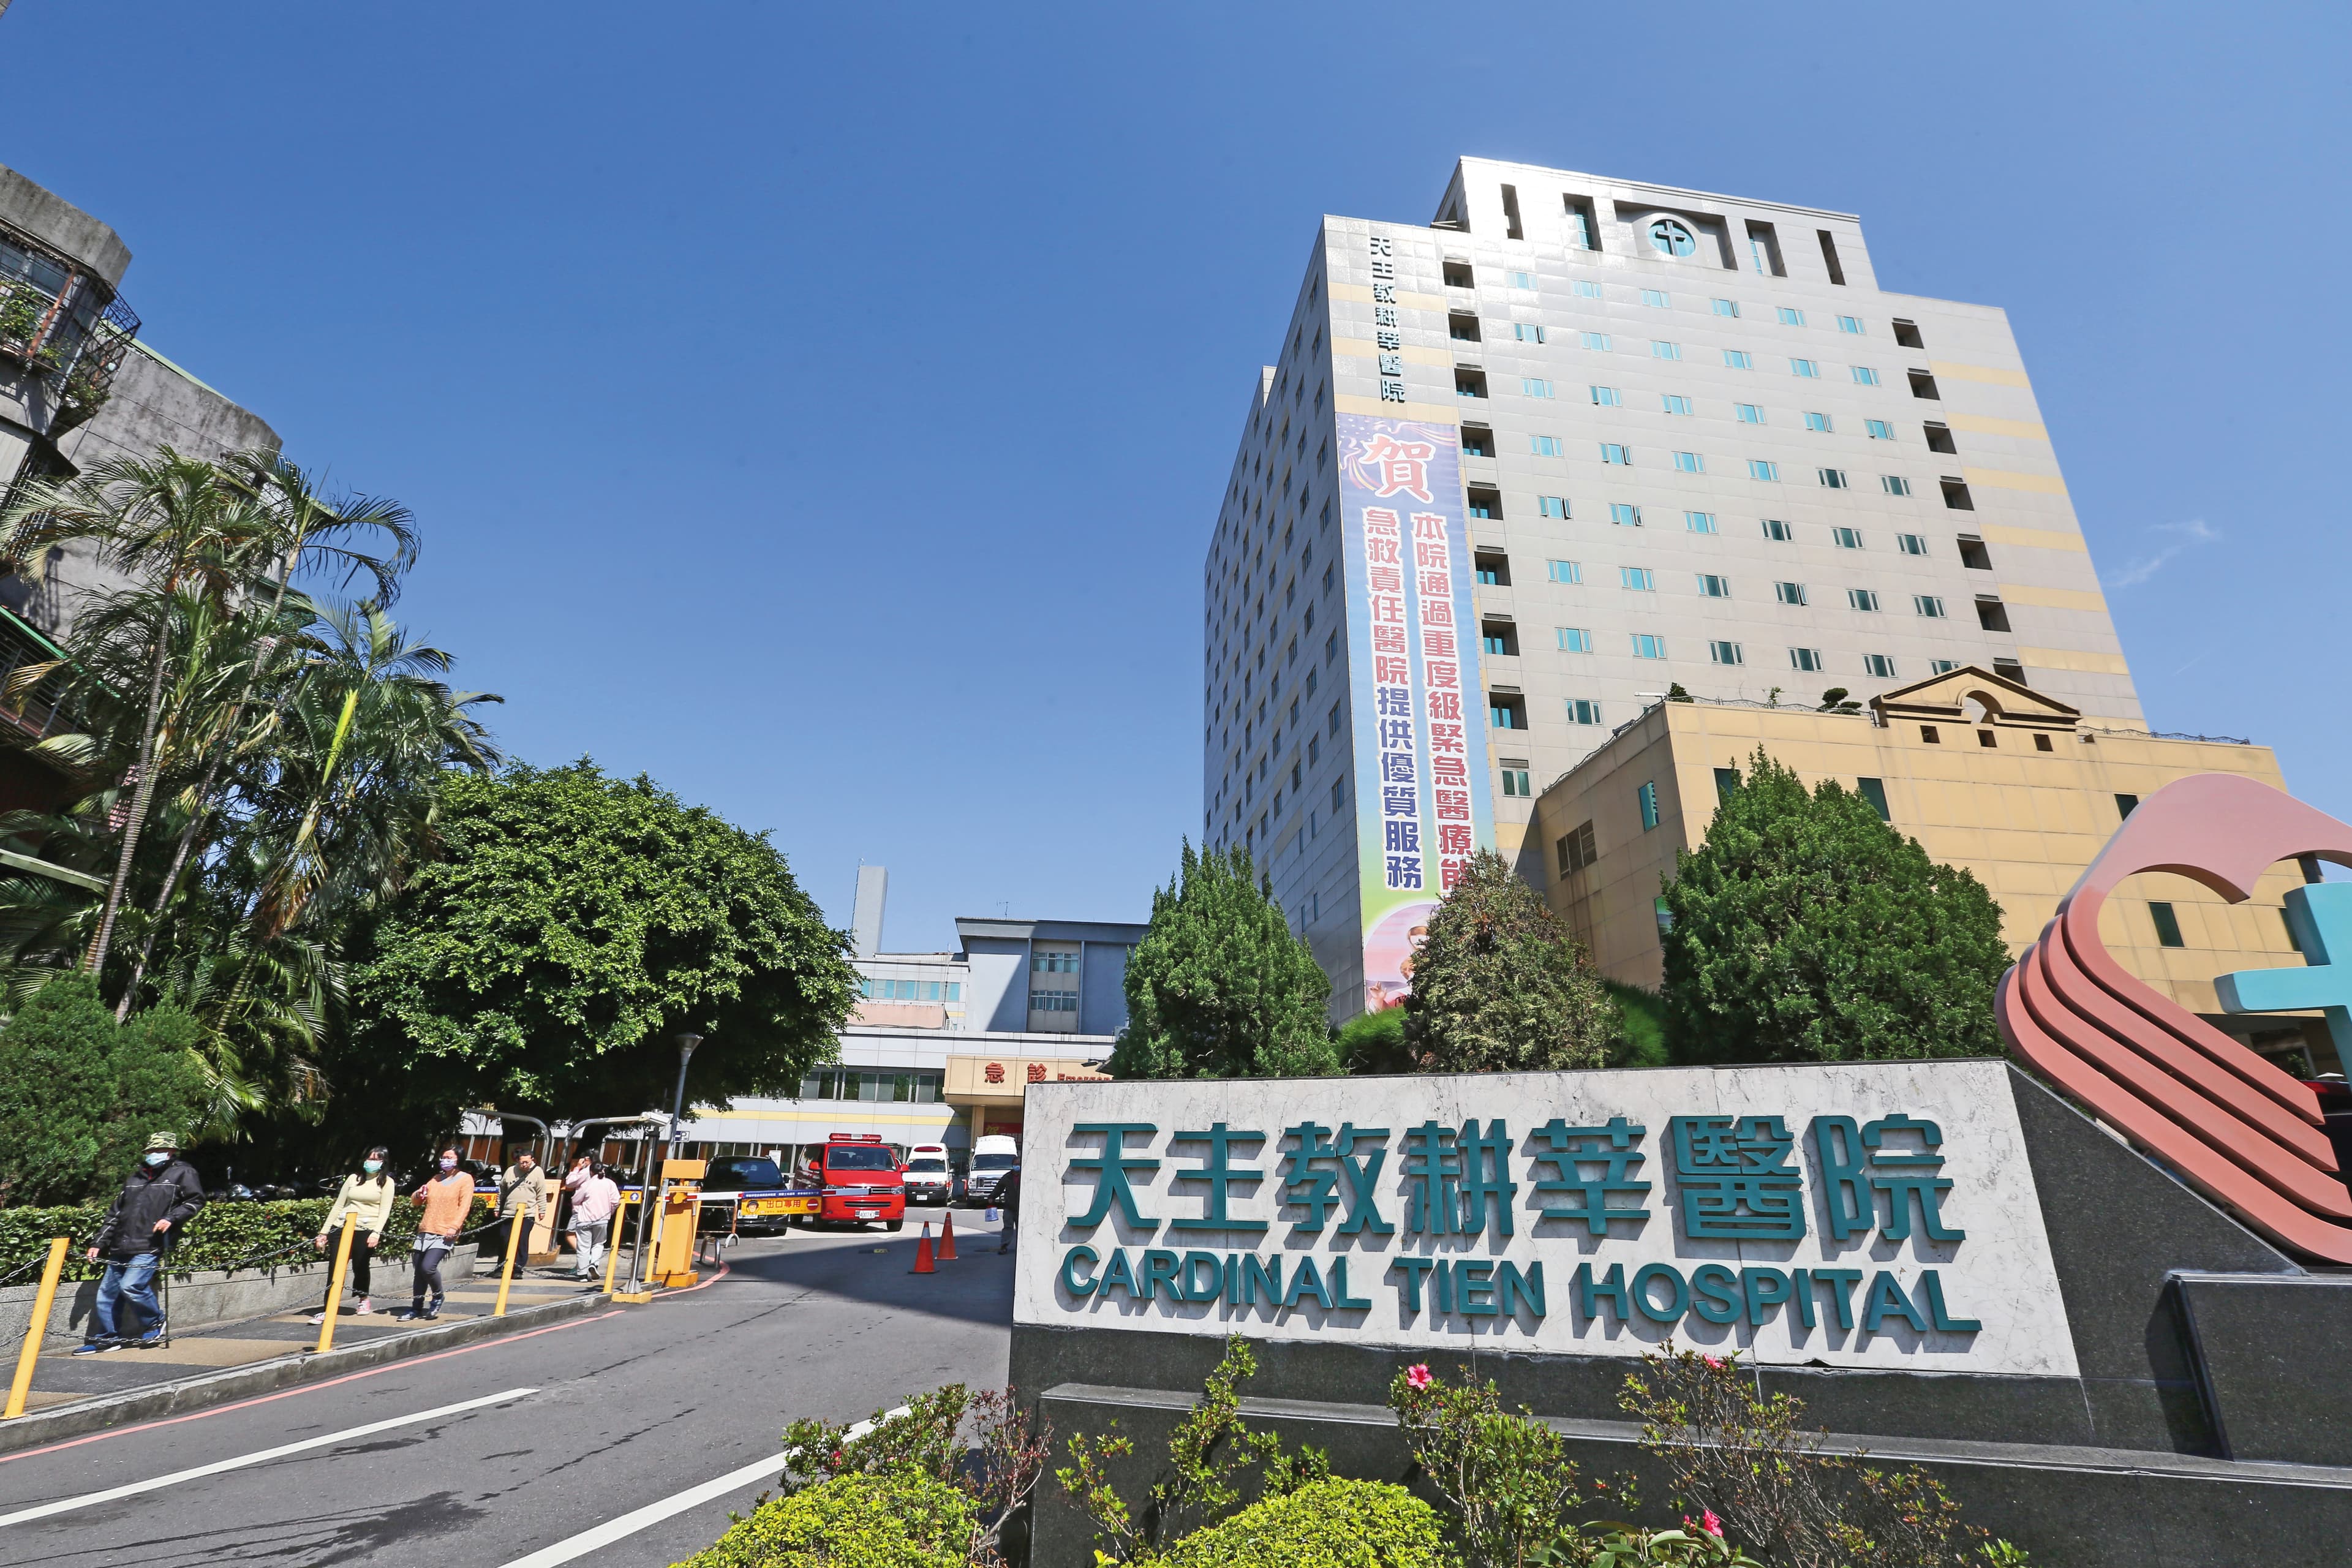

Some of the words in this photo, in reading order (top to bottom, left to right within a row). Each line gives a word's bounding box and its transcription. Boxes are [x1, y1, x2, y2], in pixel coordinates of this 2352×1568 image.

[1370, 236, 1405, 403] 天主教耕莘醫院
[1360, 434, 1434, 503] 賀
[1366, 508, 1422, 889] 急救責任醫院提供優質服務
[1413, 514, 1474, 902] 本院通過重度級緊急醫療能
[985, 1062, 1047, 1084] 急診
[1066, 1113, 1966, 1240] 天主教耕莘醫院
[1061, 1246, 1371, 1309] CARDINAL
[1393, 1257, 1546, 1317] TIEN
[1578, 1262, 1983, 1332] HOSPITAL
